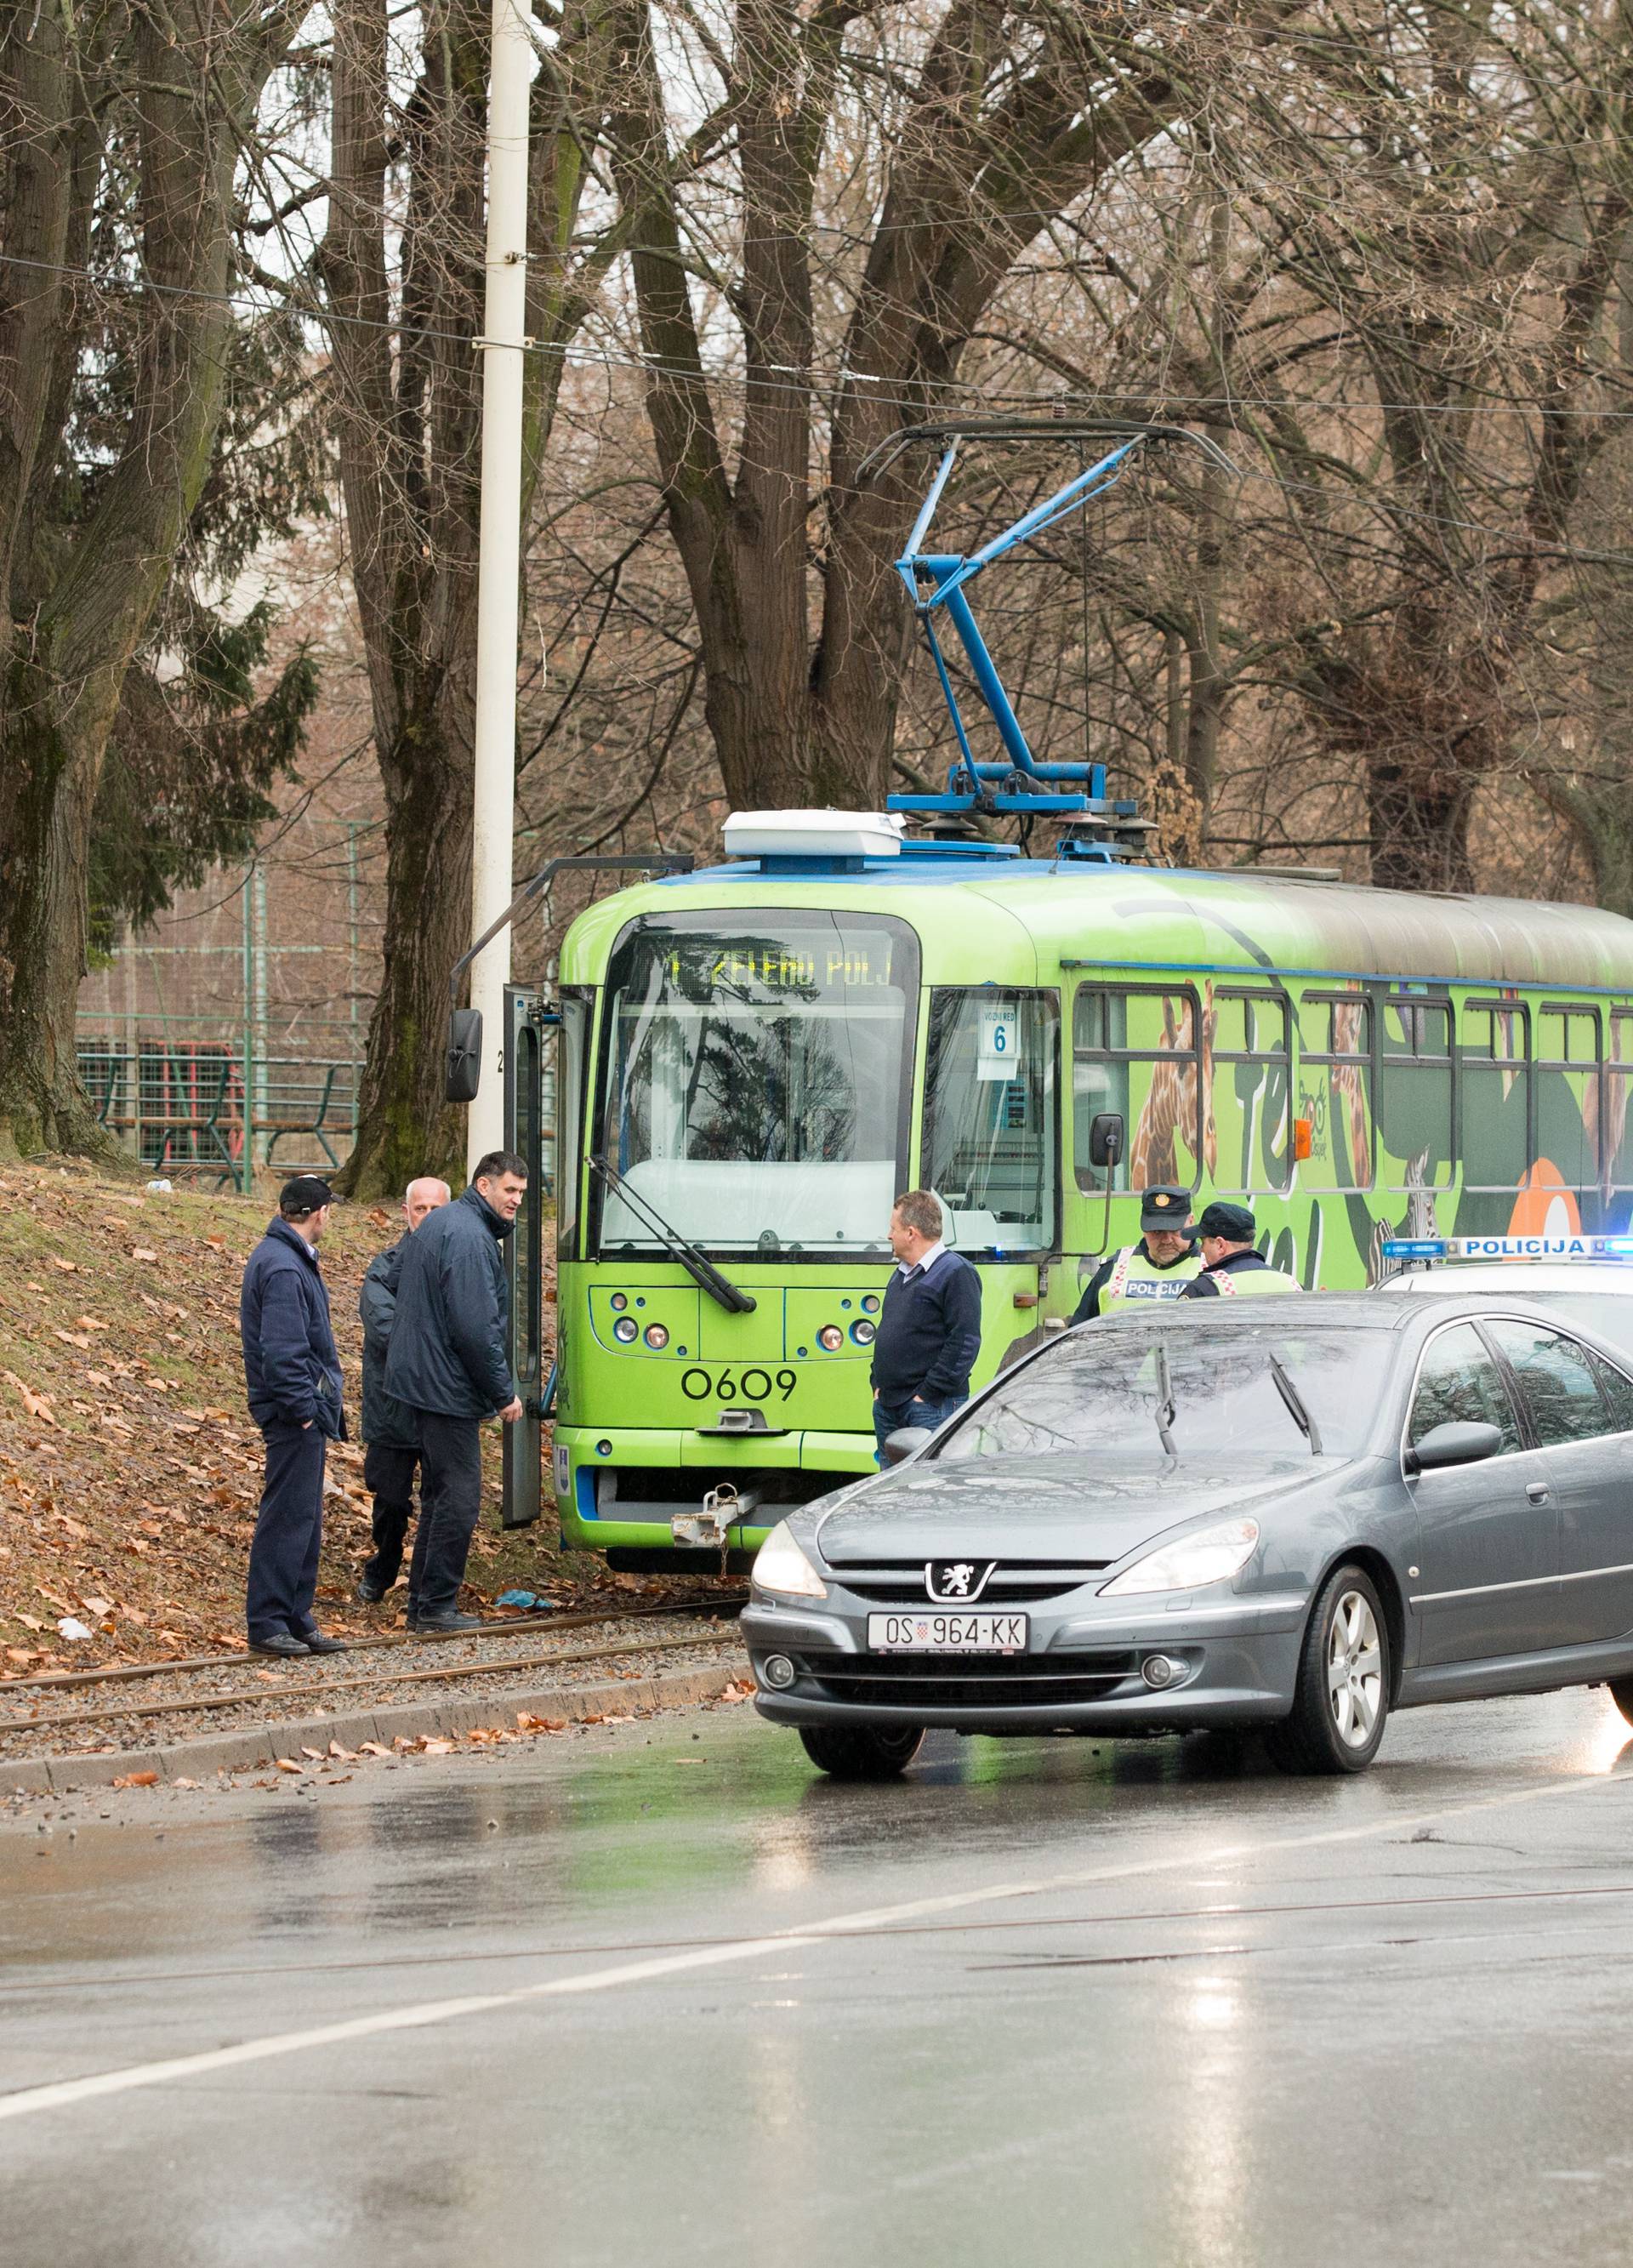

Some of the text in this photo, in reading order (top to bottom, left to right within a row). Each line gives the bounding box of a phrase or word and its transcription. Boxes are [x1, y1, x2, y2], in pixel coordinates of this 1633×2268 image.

[994, 1026, 1005, 1052] 6
[498, 1050, 504, 1073] 2
[1466, 1239, 1585, 1255] POLICIJA
[1128, 1283, 1187, 1295] POLCIJ
[680, 1368, 797, 1402] 0609
[886, 1617, 1021, 1644] OS 964-KK
